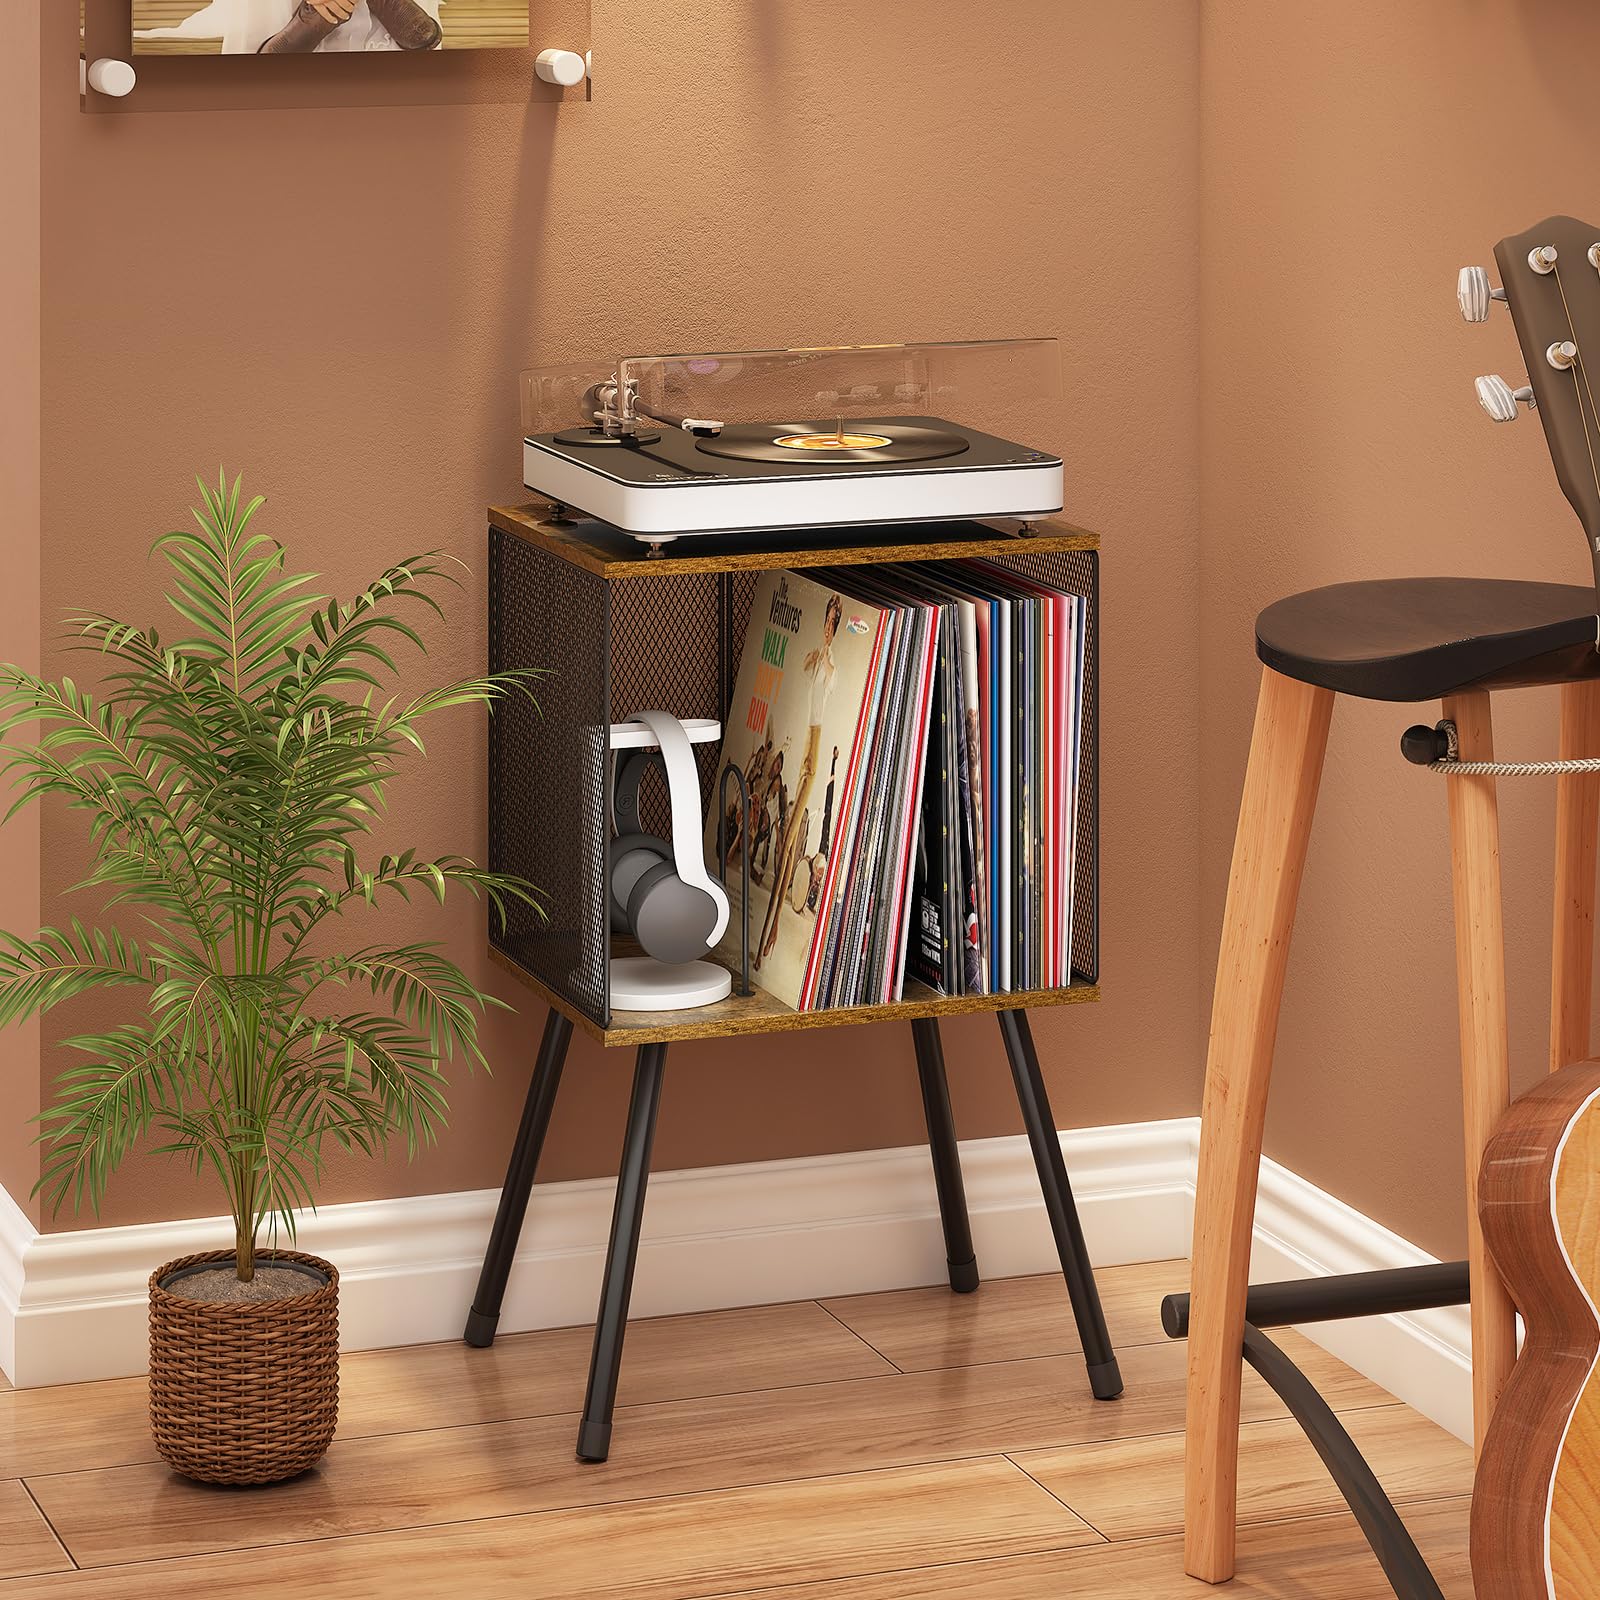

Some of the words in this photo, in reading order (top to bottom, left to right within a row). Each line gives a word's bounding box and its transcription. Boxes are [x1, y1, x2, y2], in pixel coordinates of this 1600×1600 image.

[779, 576, 789, 599] The
[769, 590, 802, 634] Ventures
[761, 627, 789, 669] WALK
[746, 696, 769, 736] RUN
